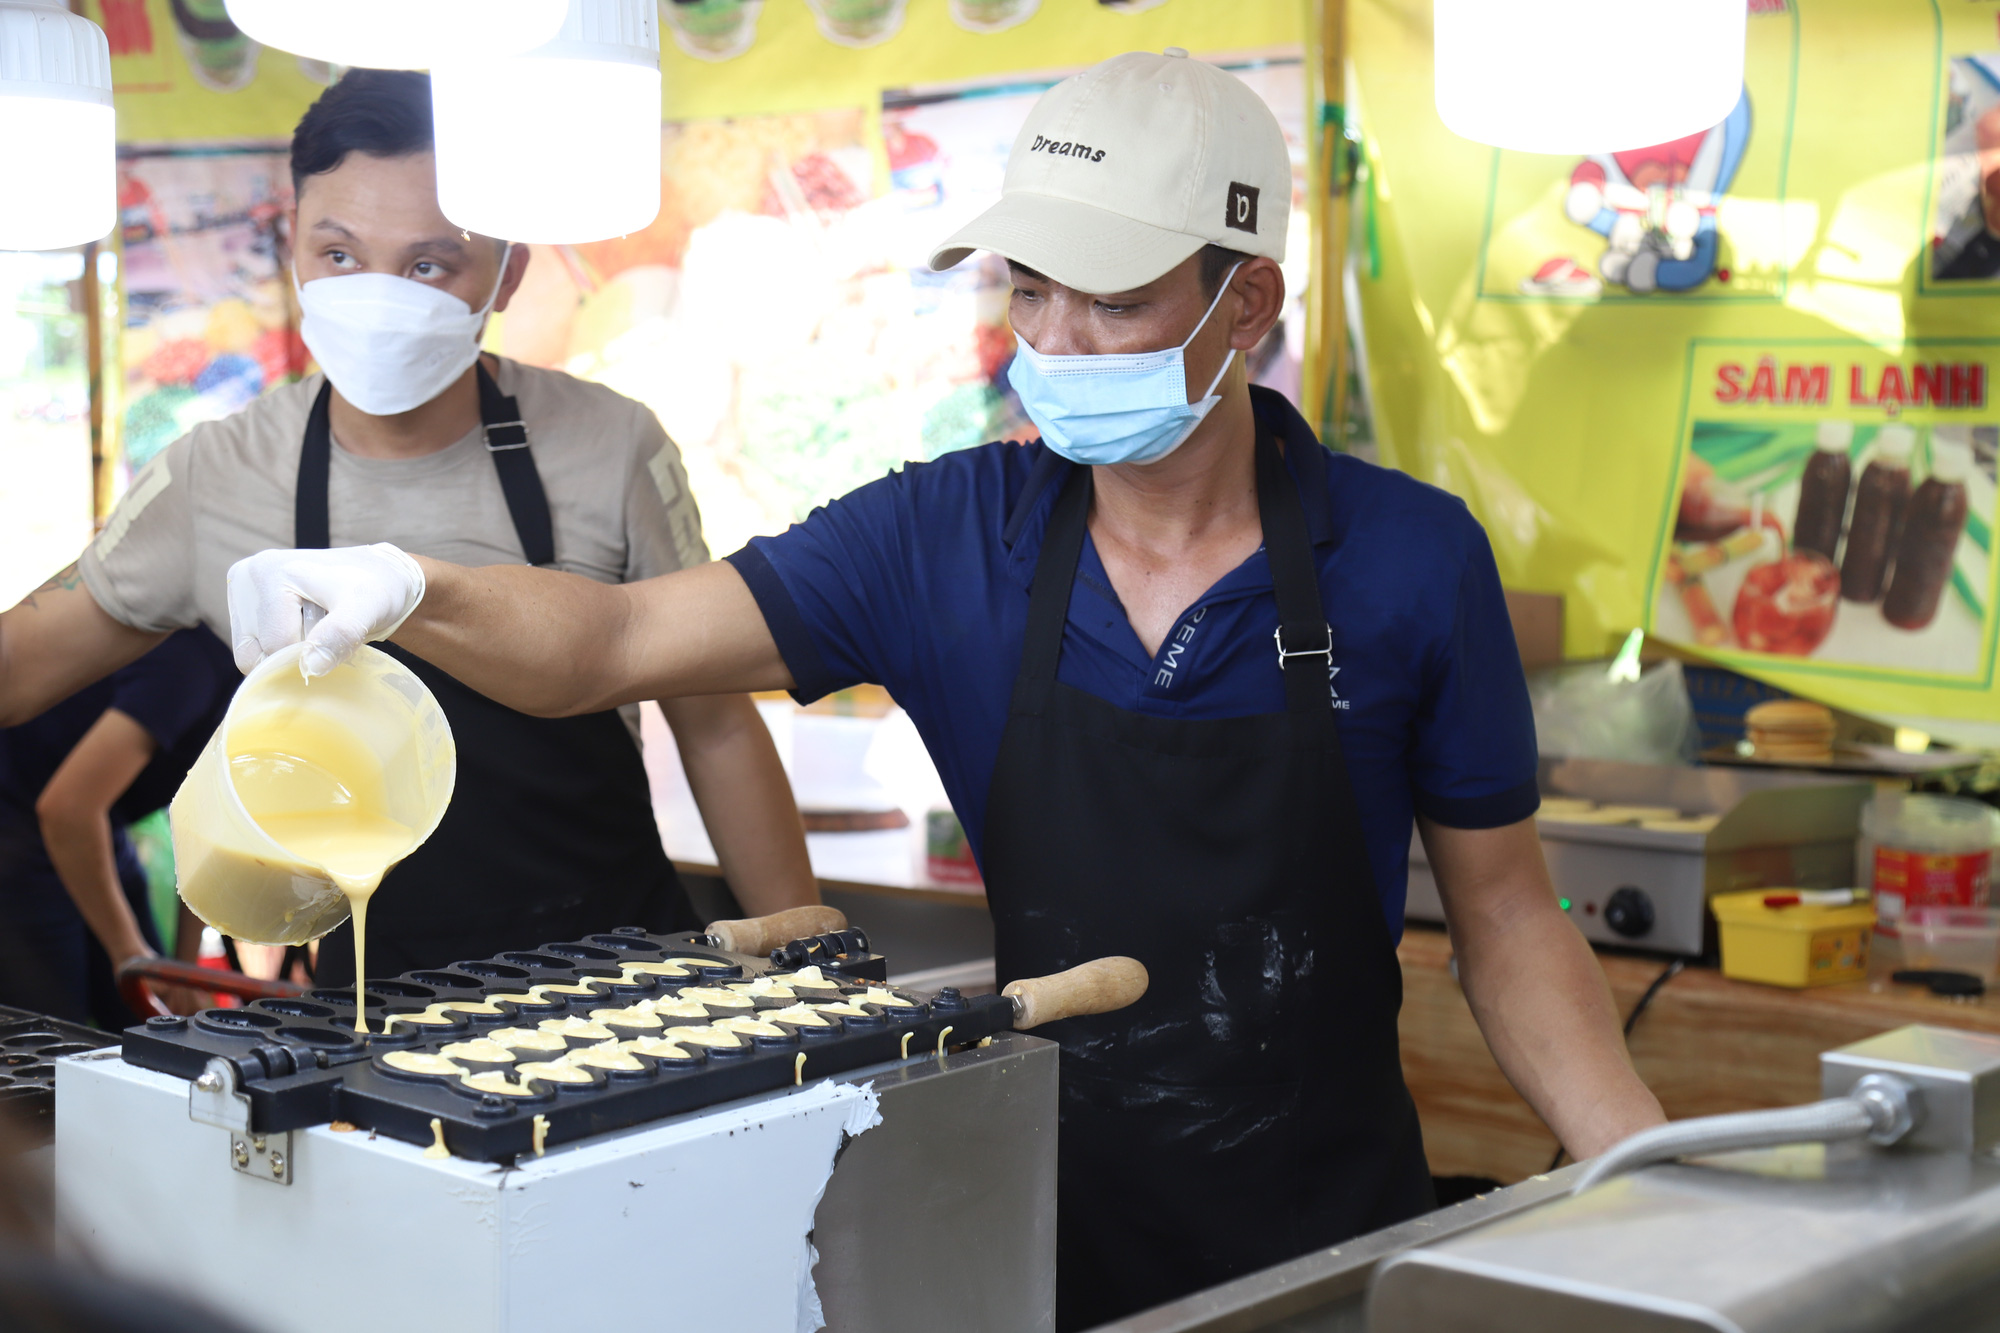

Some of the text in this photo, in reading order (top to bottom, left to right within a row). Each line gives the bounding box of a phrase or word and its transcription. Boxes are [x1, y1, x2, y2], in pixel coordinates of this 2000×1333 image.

[1031, 134, 1106, 163] Dreams
[1715, 355, 1987, 416] SÂM LẠNH
